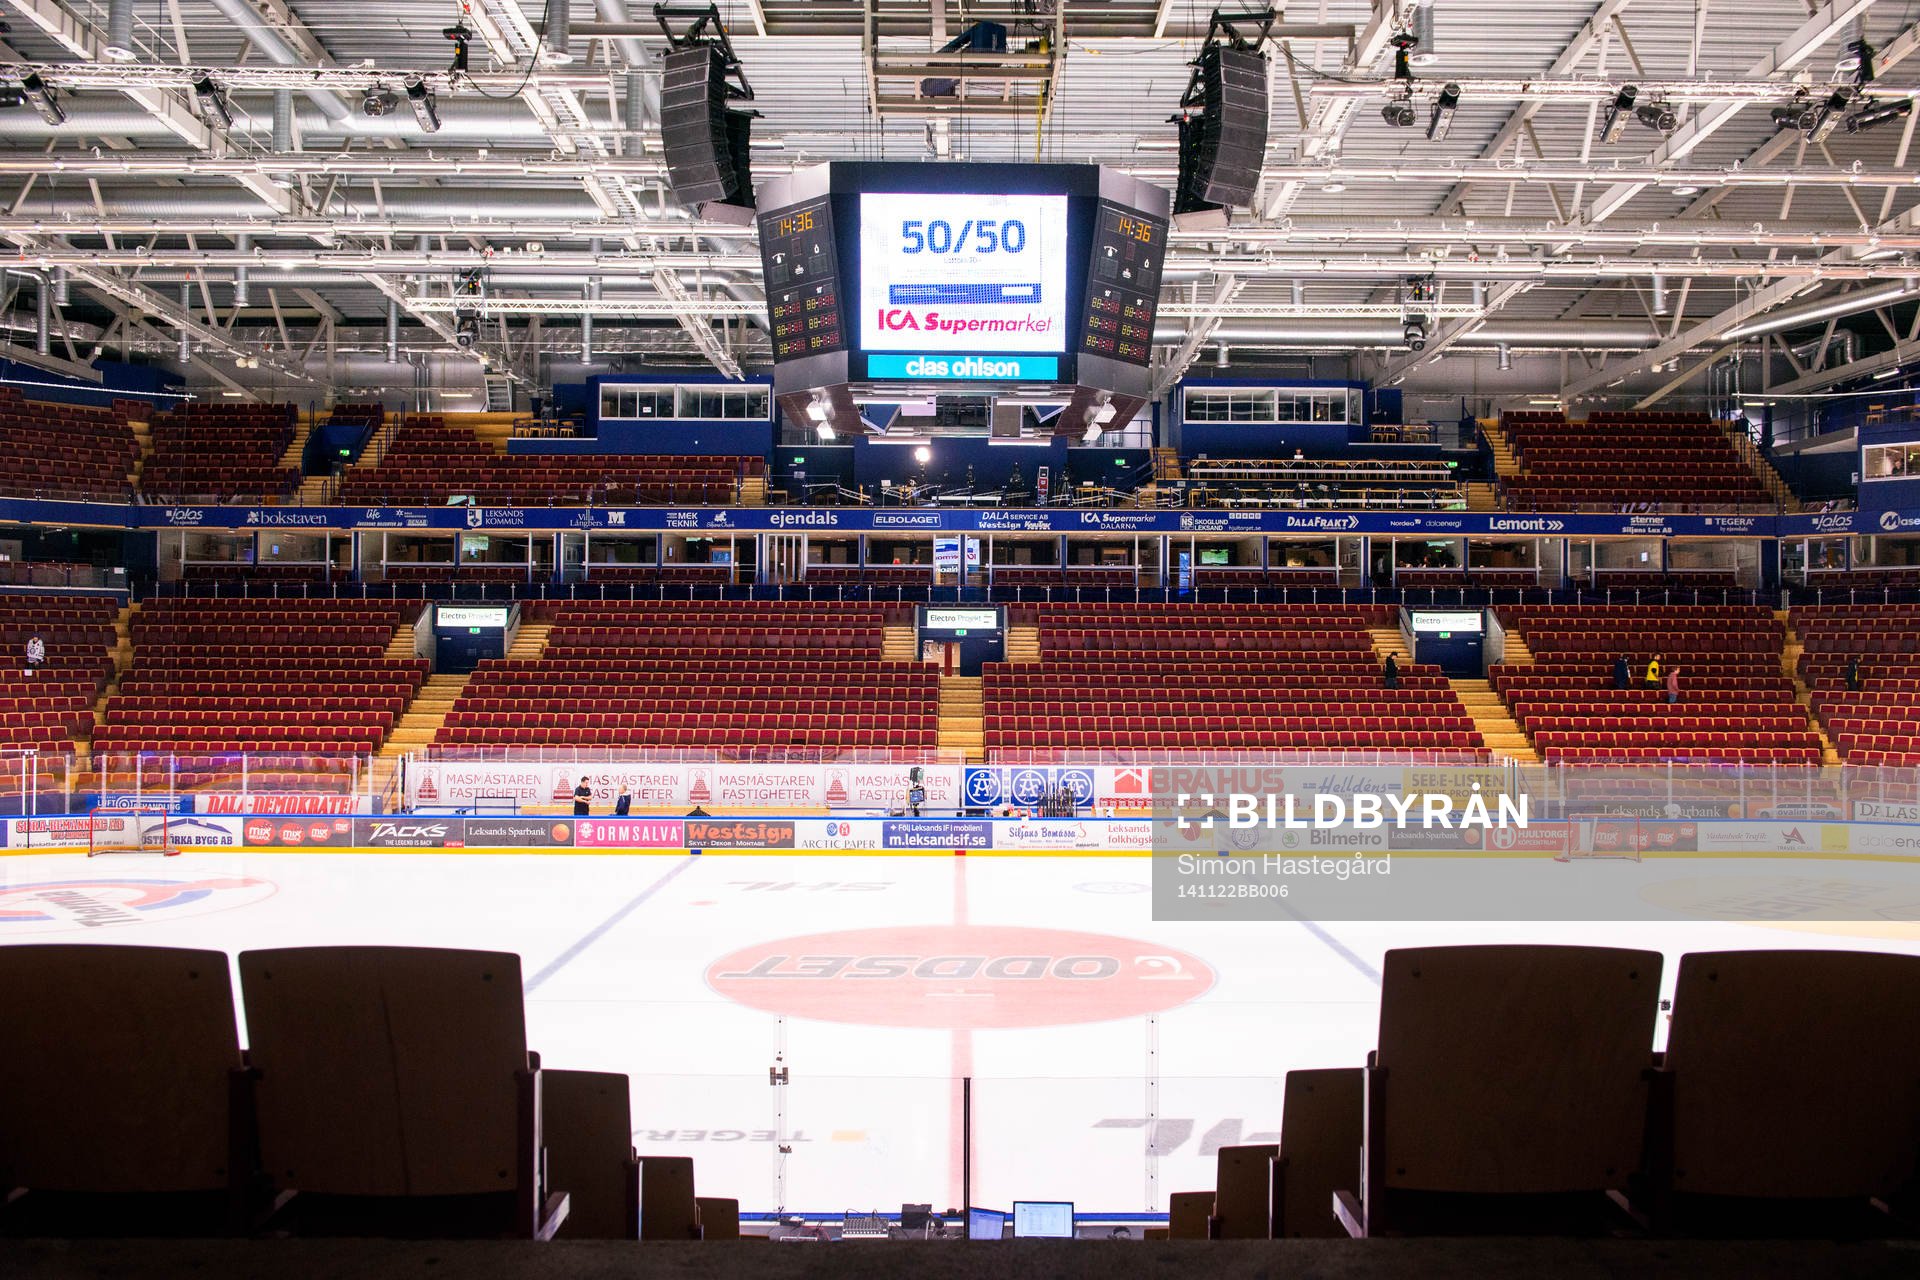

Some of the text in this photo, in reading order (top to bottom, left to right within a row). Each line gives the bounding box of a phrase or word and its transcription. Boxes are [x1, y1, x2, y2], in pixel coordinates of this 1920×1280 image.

[780, 211, 813, 236] 14:36
[1118, 216, 1152, 243] 14:36
[901, 219, 1027, 254] 50/50
[878, 309, 1053, 336] ICA Supermarket
[906, 357, 1020, 377] clas ohlson
[261, 511, 327, 524] bokstaven
[577, 513, 594, 521] Via
[769, 511, 838, 528] ejendals
[875, 516, 939, 524] ELBOLAGET
[982, 511, 1009, 520] DALA
[1080, 512, 1156, 523] ICA Supermarket
[1815, 514, 1853, 530] jalas
[1425, 519, 1462, 528] dalaenergi
[1489, 517, 1545, 530] Lemont
[440, 612, 467, 620] Electro
[930, 614, 956, 622] Electro
[446, 772, 542, 785] MASMÄSTAREN
[718, 773, 815, 786] MASMÄSTAREN
[1148, 768, 1285, 793] BRAHUS
[449, 787, 537, 799] FASTIGHETER
[722, 788, 810, 800] FASTIGHETER
[859, 789, 947, 801] FASTIGTER
[1664, 804, 1721, 819] arbank
[369, 823, 449, 841] TACKS
[469, 826, 546, 838] Leksands Sparbank
[597, 825, 678, 842] ORMSALVA
[687, 823, 793, 844] Westsign
[898, 824, 910, 832] Följ
[1009, 827, 1039, 840] Siljans
[1108, 824, 1150, 833] Leksands
[195, 836, 218, 845] BYGG
[221, 836, 233, 845] AB
[889, 834, 987, 846] m.leksandsif.se
[1108, 835, 1168, 846] folkhögskola
[1310, 829, 1382, 846] Bilmetro
[1391, 831, 1459, 841] Leksands Sparbank
[801, 839, 876, 848] ARCTIC PAPER
[717, 955, 1122, 980] ODDSET
